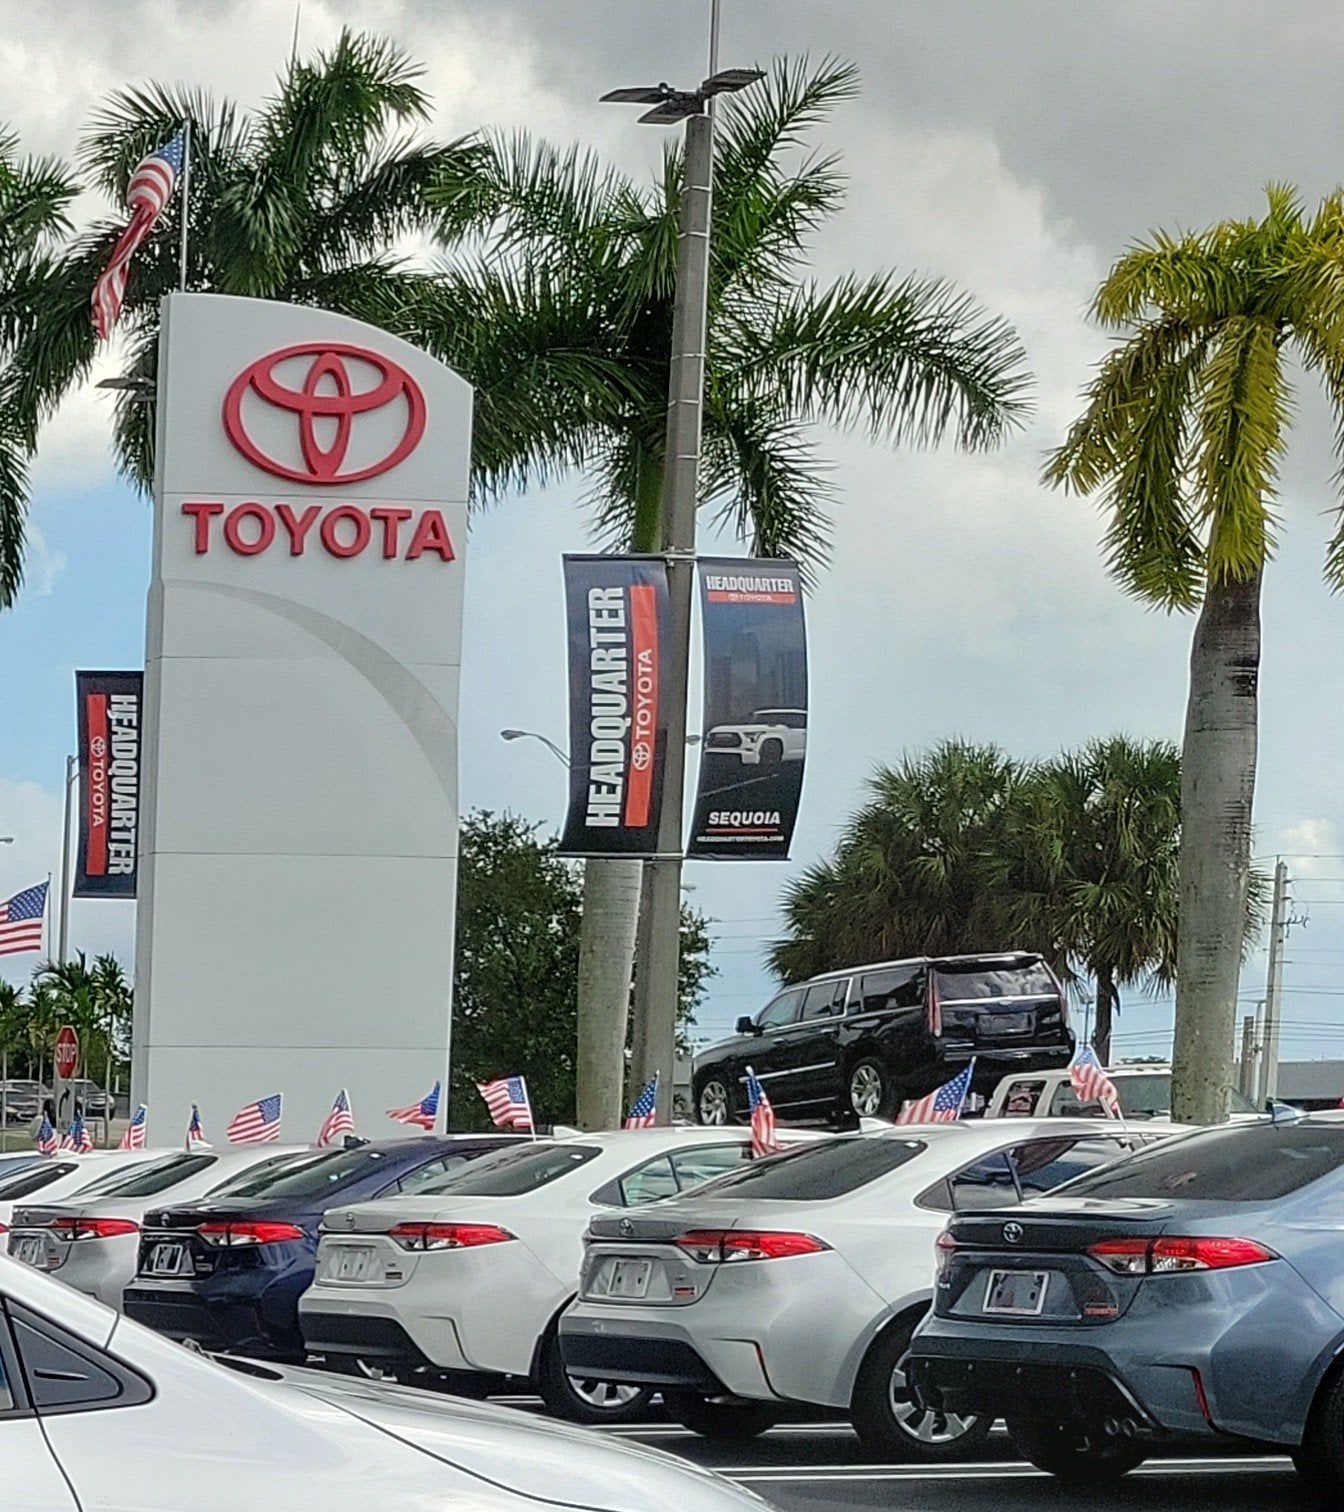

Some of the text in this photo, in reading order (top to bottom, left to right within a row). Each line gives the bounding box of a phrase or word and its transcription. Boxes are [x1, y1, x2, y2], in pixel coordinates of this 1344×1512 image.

[181, 502, 456, 562] TOYOTA
[706, 575, 794, 593] HEADQUARTER
[585, 586, 631, 827] HEADQUARTER
[636, 649, 653, 743] TOYOTA
[91, 758, 105, 828] TOYOTA
[107, 694, 140, 875] HEADQUARTER
[708, 811, 781, 827] SEQUOIA
[57, 1043, 76, 1062] STOP
